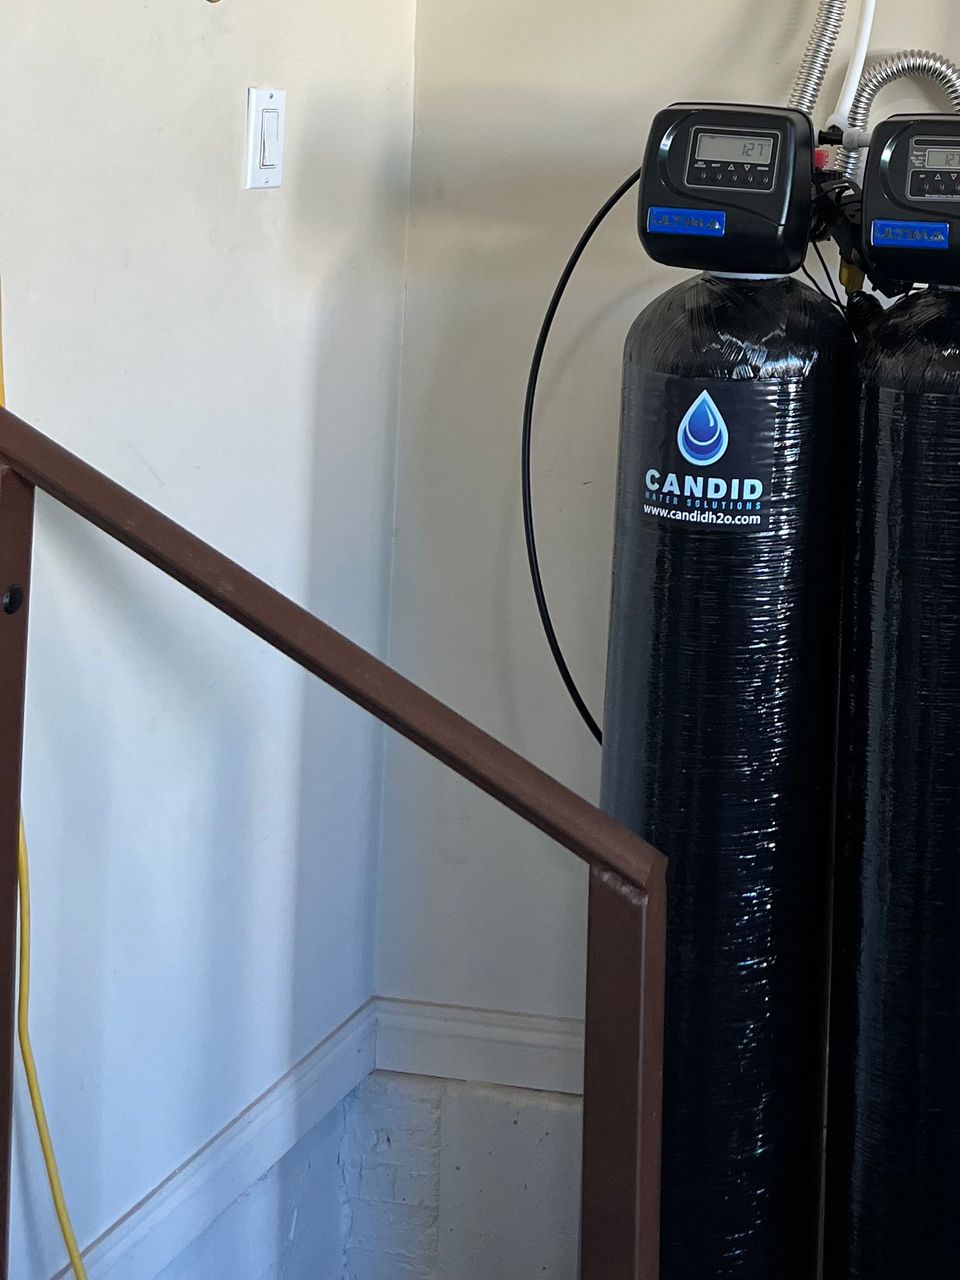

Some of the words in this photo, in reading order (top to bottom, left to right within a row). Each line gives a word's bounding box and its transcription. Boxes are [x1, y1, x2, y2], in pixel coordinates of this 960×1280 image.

[645, 468, 764, 500] CANDID
[644, 491, 678, 505] WATER
[686, 499, 762, 510] SOLUTIONS
[643, 503, 761, 525] www.candidh2o.com
